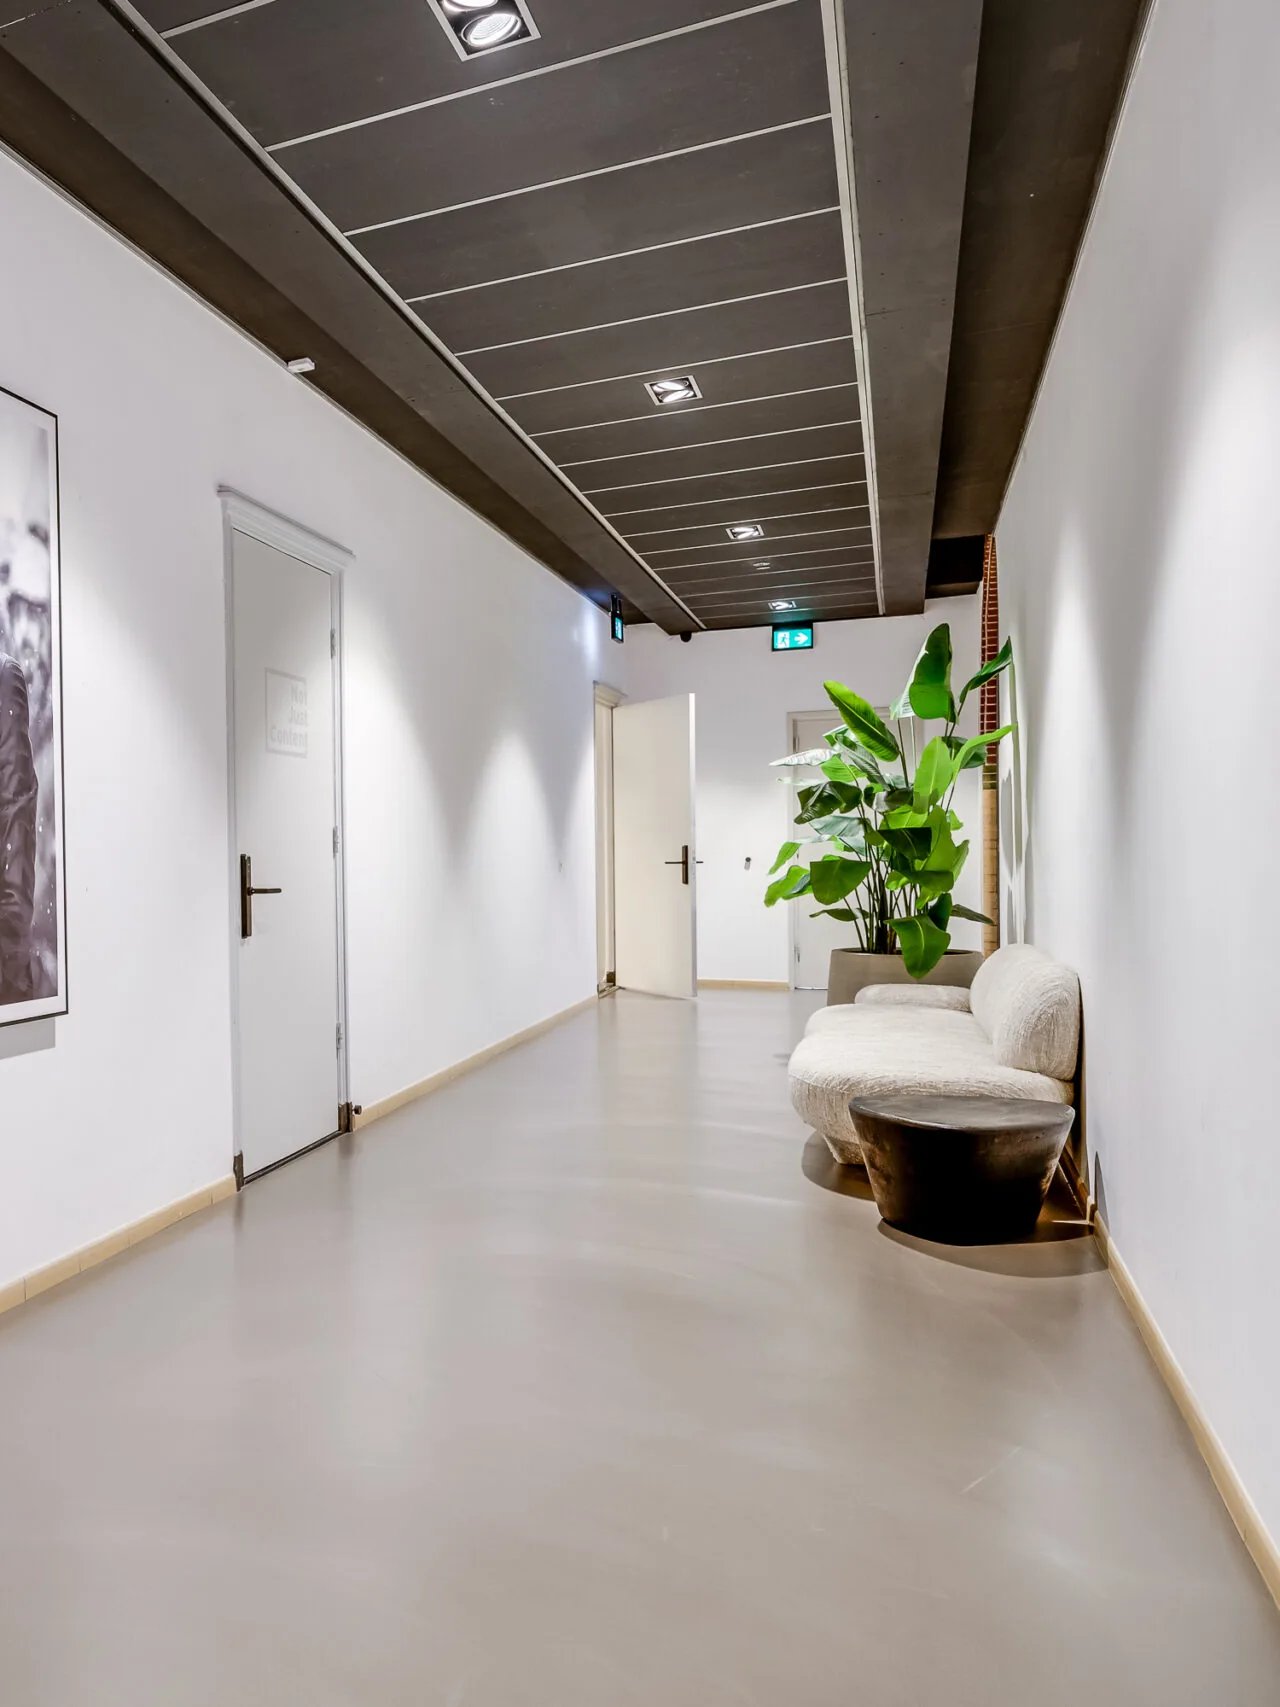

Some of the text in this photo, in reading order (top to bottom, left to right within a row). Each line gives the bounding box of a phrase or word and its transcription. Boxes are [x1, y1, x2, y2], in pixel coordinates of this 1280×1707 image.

[291, 684, 307, 706] Not
[288, 706, 308, 727] Just
[270, 725, 308, 748] Content
